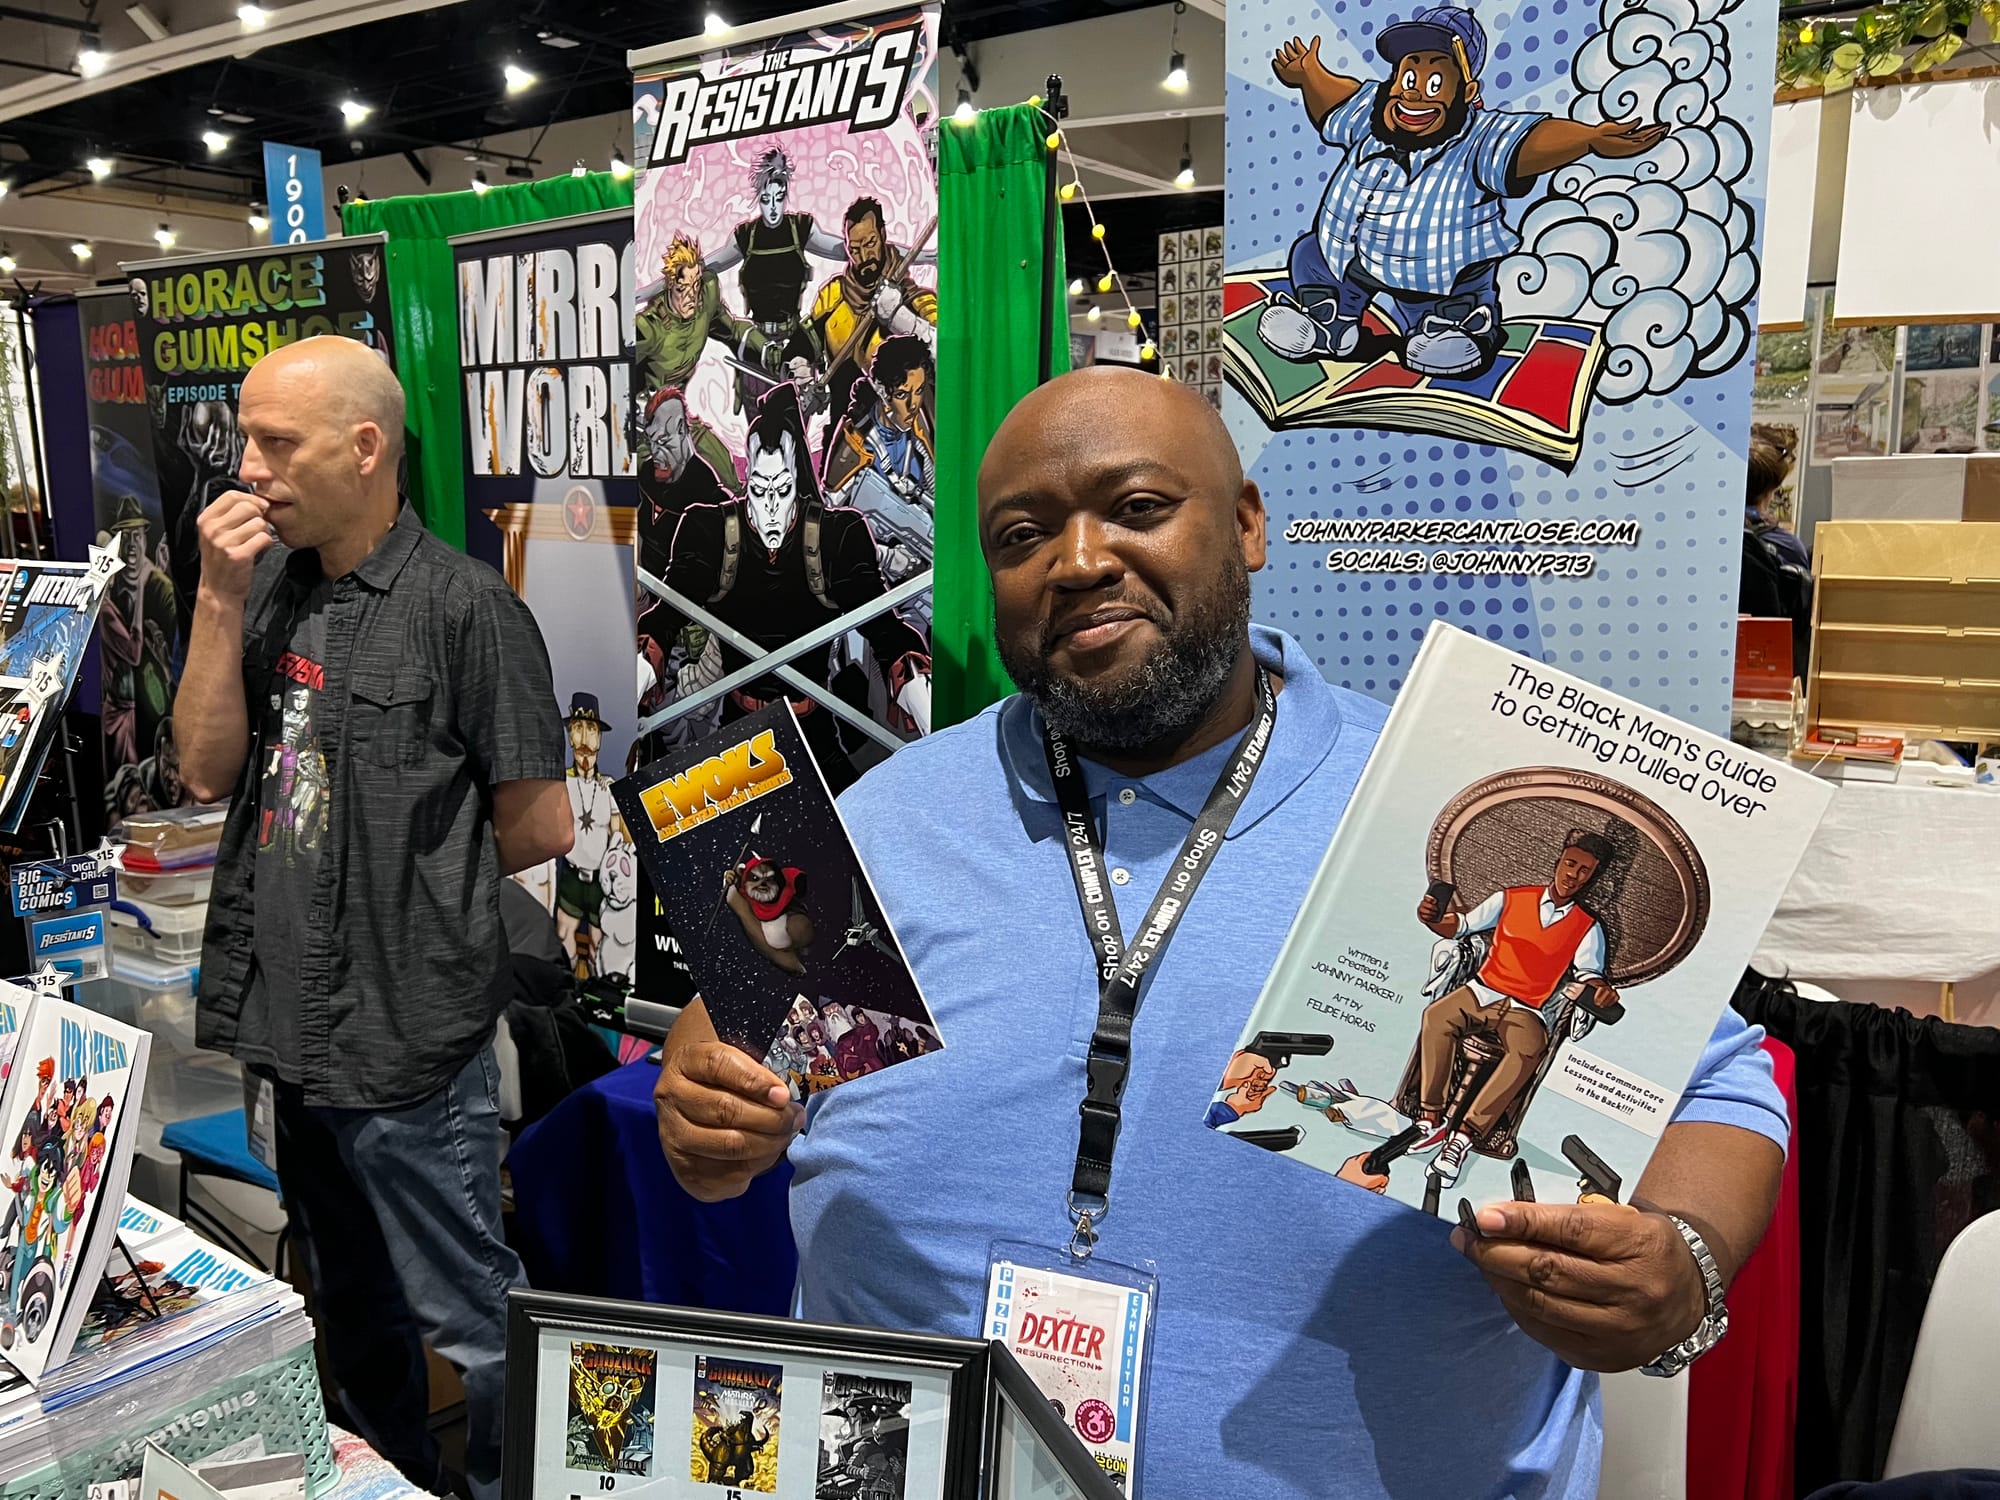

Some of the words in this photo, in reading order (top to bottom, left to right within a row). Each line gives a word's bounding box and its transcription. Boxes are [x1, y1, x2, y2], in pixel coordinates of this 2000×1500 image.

[764, 52, 790, 72] THE
[652, 30, 915, 162] RESISTANTS
[285, 154, 306, 245] 1900
[151, 253, 325, 323] HORACE
[167, 384, 227, 403] EPISODE
[1286, 521, 1638, 543] JOHNNYPARKERCANTLOSE.COM
[95, 555, 114, 574] $15
[1328, 550, 1426, 572] SOCIALS:
[1431, 552, 1594, 575] @JOHNNYP313
[35, 671, 52, 692] $15
[1265, 693, 1274, 712] on
[1242, 713, 1273, 765] COMPLEX
[1506, 663, 1554, 700] The
[1556, 685, 1626, 731] Black
[1627, 715, 1701, 763] Man's
[1705, 750, 1777, 794] Guide
[1052, 741, 1071, 778] Shop
[1490, 690, 1517, 717] to
[1522, 705, 1618, 763] Getting
[1619, 744, 1700, 794] Pulled
[1701, 779, 1767, 818] Over
[640, 729, 787, 833] EWOKS
[1225, 761, 1252, 798] 24/7
[1067, 811, 1089, 846] 24/7
[97, 849, 114, 861] $15
[1184, 828, 1218, 870] Shop
[18, 870, 41, 885] BIG
[18, 881, 53, 898] BLUE
[1075, 848, 1104, 904] COMPLEX
[1171, 871, 1192, 893] on
[20, 891, 73, 911] COMICS
[40, 925, 96, 949] RESISTANTS
[1094, 909, 1111, 932] on
[1139, 896, 1182, 949] COMPLEX
[1103, 934, 1118, 982] Shop
[1120, 950, 1150, 989] 24/7
[1337, 955, 1376, 977] Created
[1376, 970, 1389, 983] by
[1382, 961, 1390, 970] &
[36, 975, 56, 986] $15
[1311, 961, 1355, 983] JOHNNY
[1354, 977, 1395, 1002] PARKER
[1306, 997, 1340, 1018] FELIPE
[1339, 1011, 1376, 1032] HORAS
[1332, 993, 1350, 1005] Art
[1349, 999, 1364, 1012] by
[60, 1016, 128, 1083] BROKEN
[1563, 1065, 1597, 1086] Lessons
[1597, 1080, 1616, 1094] and
[1614, 1090, 1657, 1114] Activities
[1567, 1054, 1604, 1076] Includes
[1604, 1072, 1643, 1094] Common
[1643, 1089, 1665, 1104] Core
[1575, 1083, 1585, 1095] in
[1585, 1088, 1601, 1101] the
[1600, 1096, 1635, 1116] Back!!!!
[1018, 1313, 1105, 1361] DEXTER
[1121, 1294, 1140, 1408] EXHIBITOR
[584, 1353, 652, 1376] GODZILLA
[1016, 1347, 1096, 1370] RESURRECTION
[599, 1475, 616, 1491] 10
[726, 1489, 742, 1500] 15
